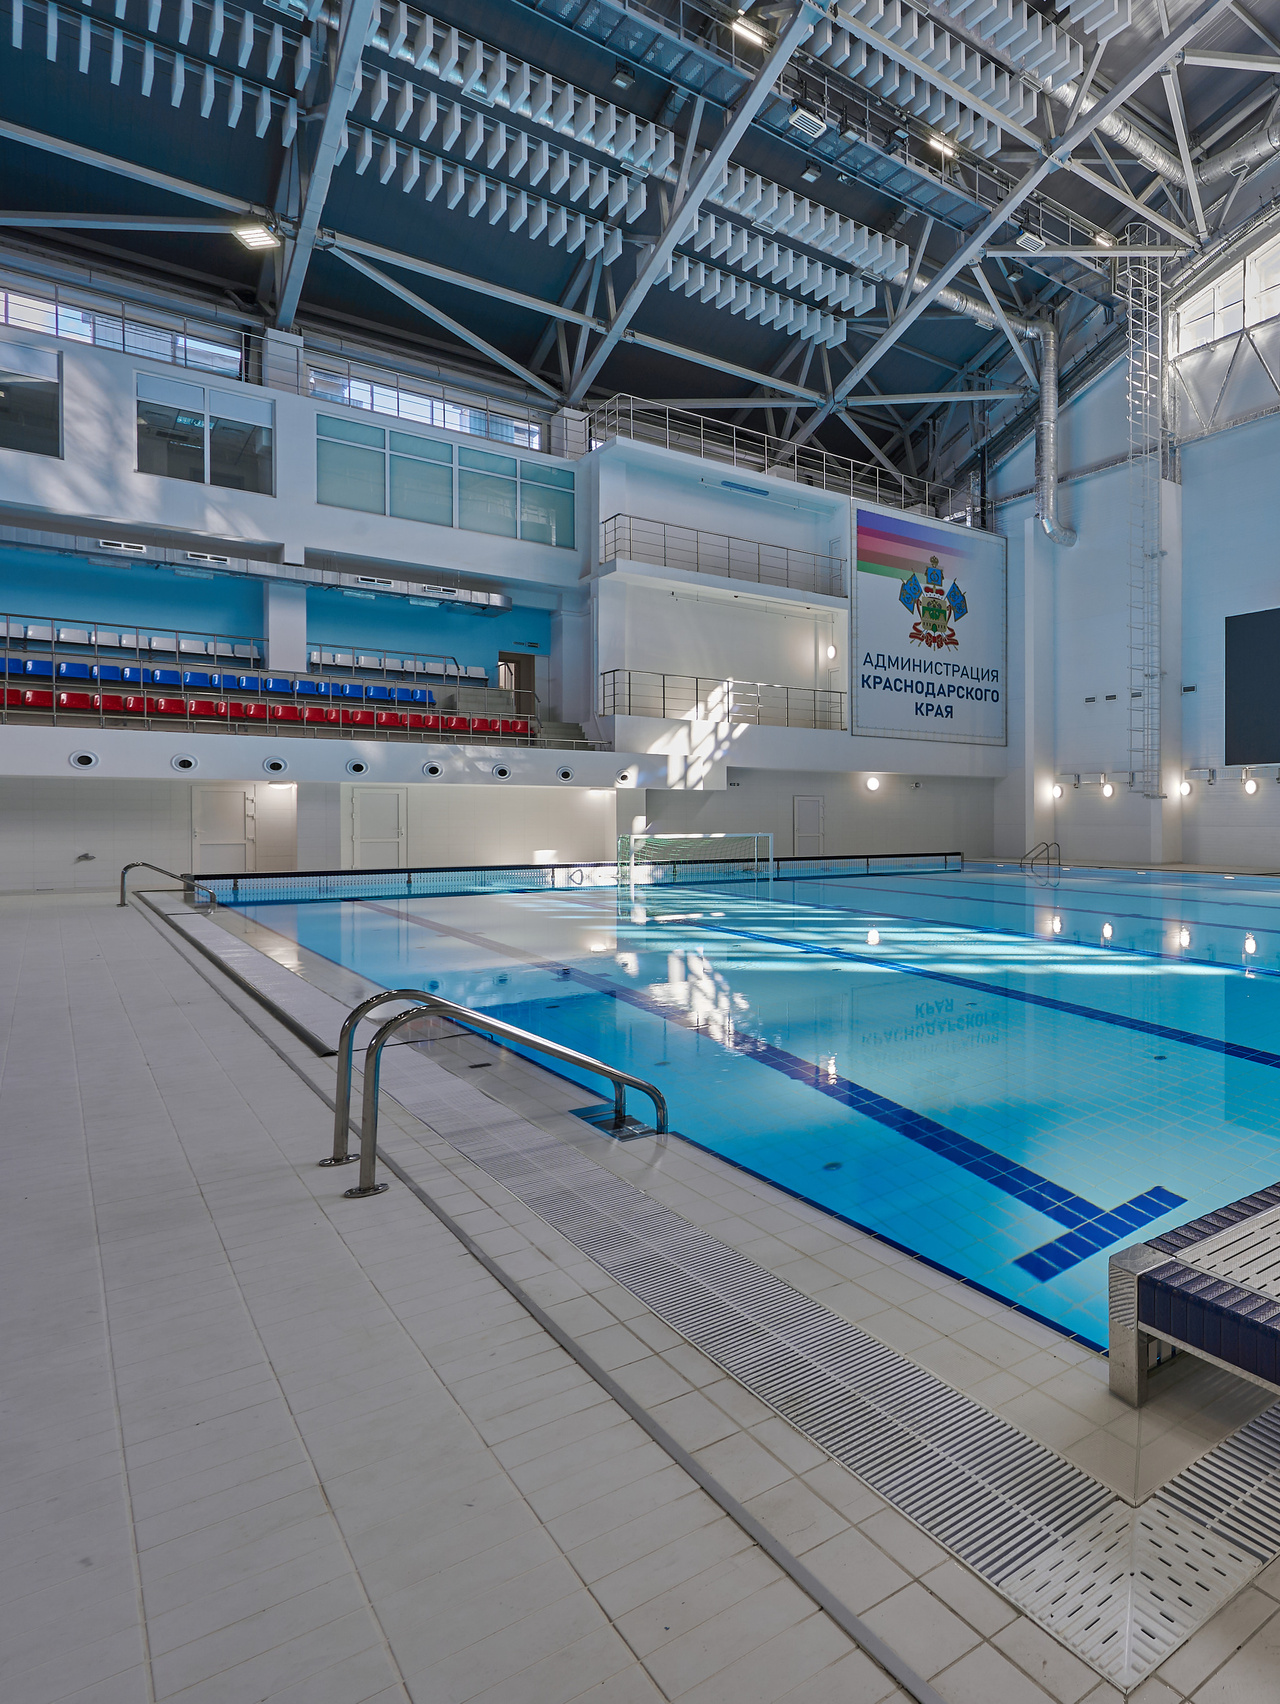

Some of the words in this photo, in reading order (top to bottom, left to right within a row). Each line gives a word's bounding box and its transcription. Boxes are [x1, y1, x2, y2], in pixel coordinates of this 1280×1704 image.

[862, 652, 999, 683] АДМИНИСТРАЦИЯ
[861, 674, 1000, 703] КРАСНОДАРСКОГО
[915, 702, 954, 719] КРАЯ
